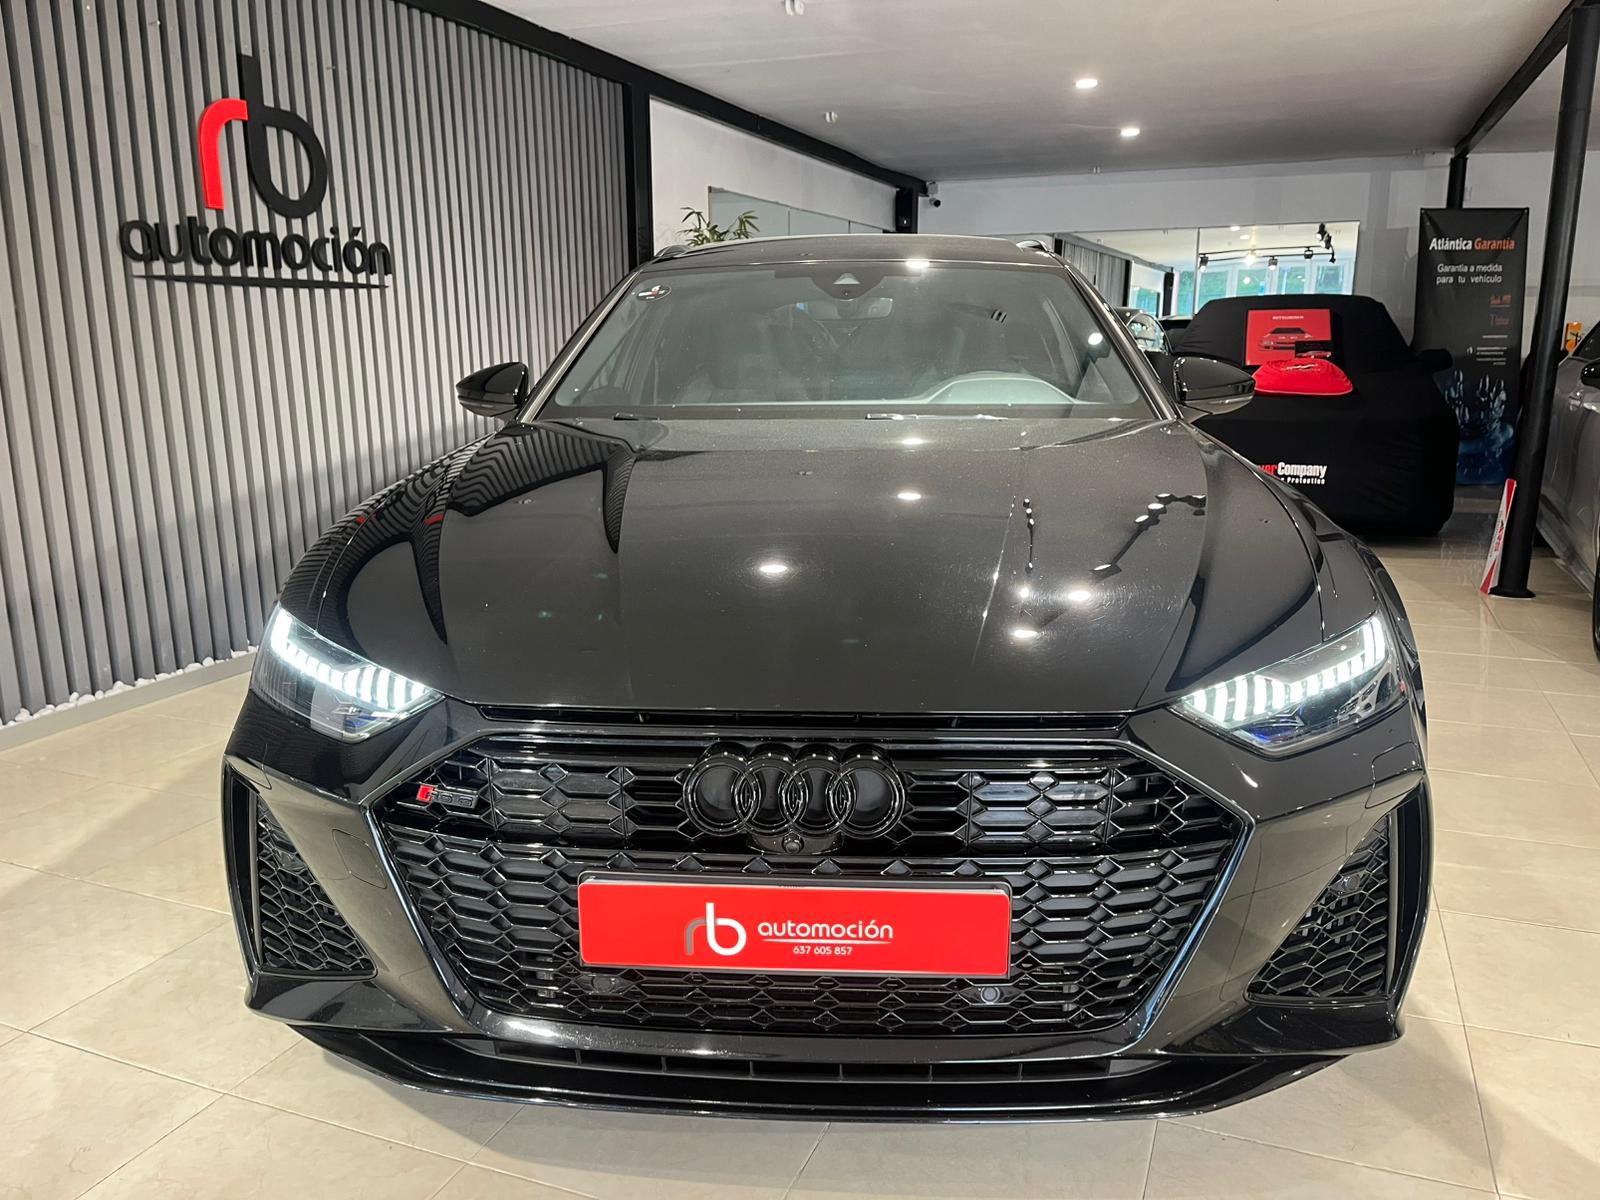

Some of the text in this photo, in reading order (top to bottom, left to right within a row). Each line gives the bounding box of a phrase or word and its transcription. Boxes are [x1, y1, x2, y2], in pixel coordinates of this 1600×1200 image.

[120, 216, 392, 275] automoción
[1429, 237, 1472, 251] Atlántica
[1476, 263, 1503, 273] medida
[1436, 274, 1502, 285] para tu vehículo
[684, 902, 747, 956] rb
[757, 919, 893, 939] automoción
[793, 945, 853, 956] 637 605 857
